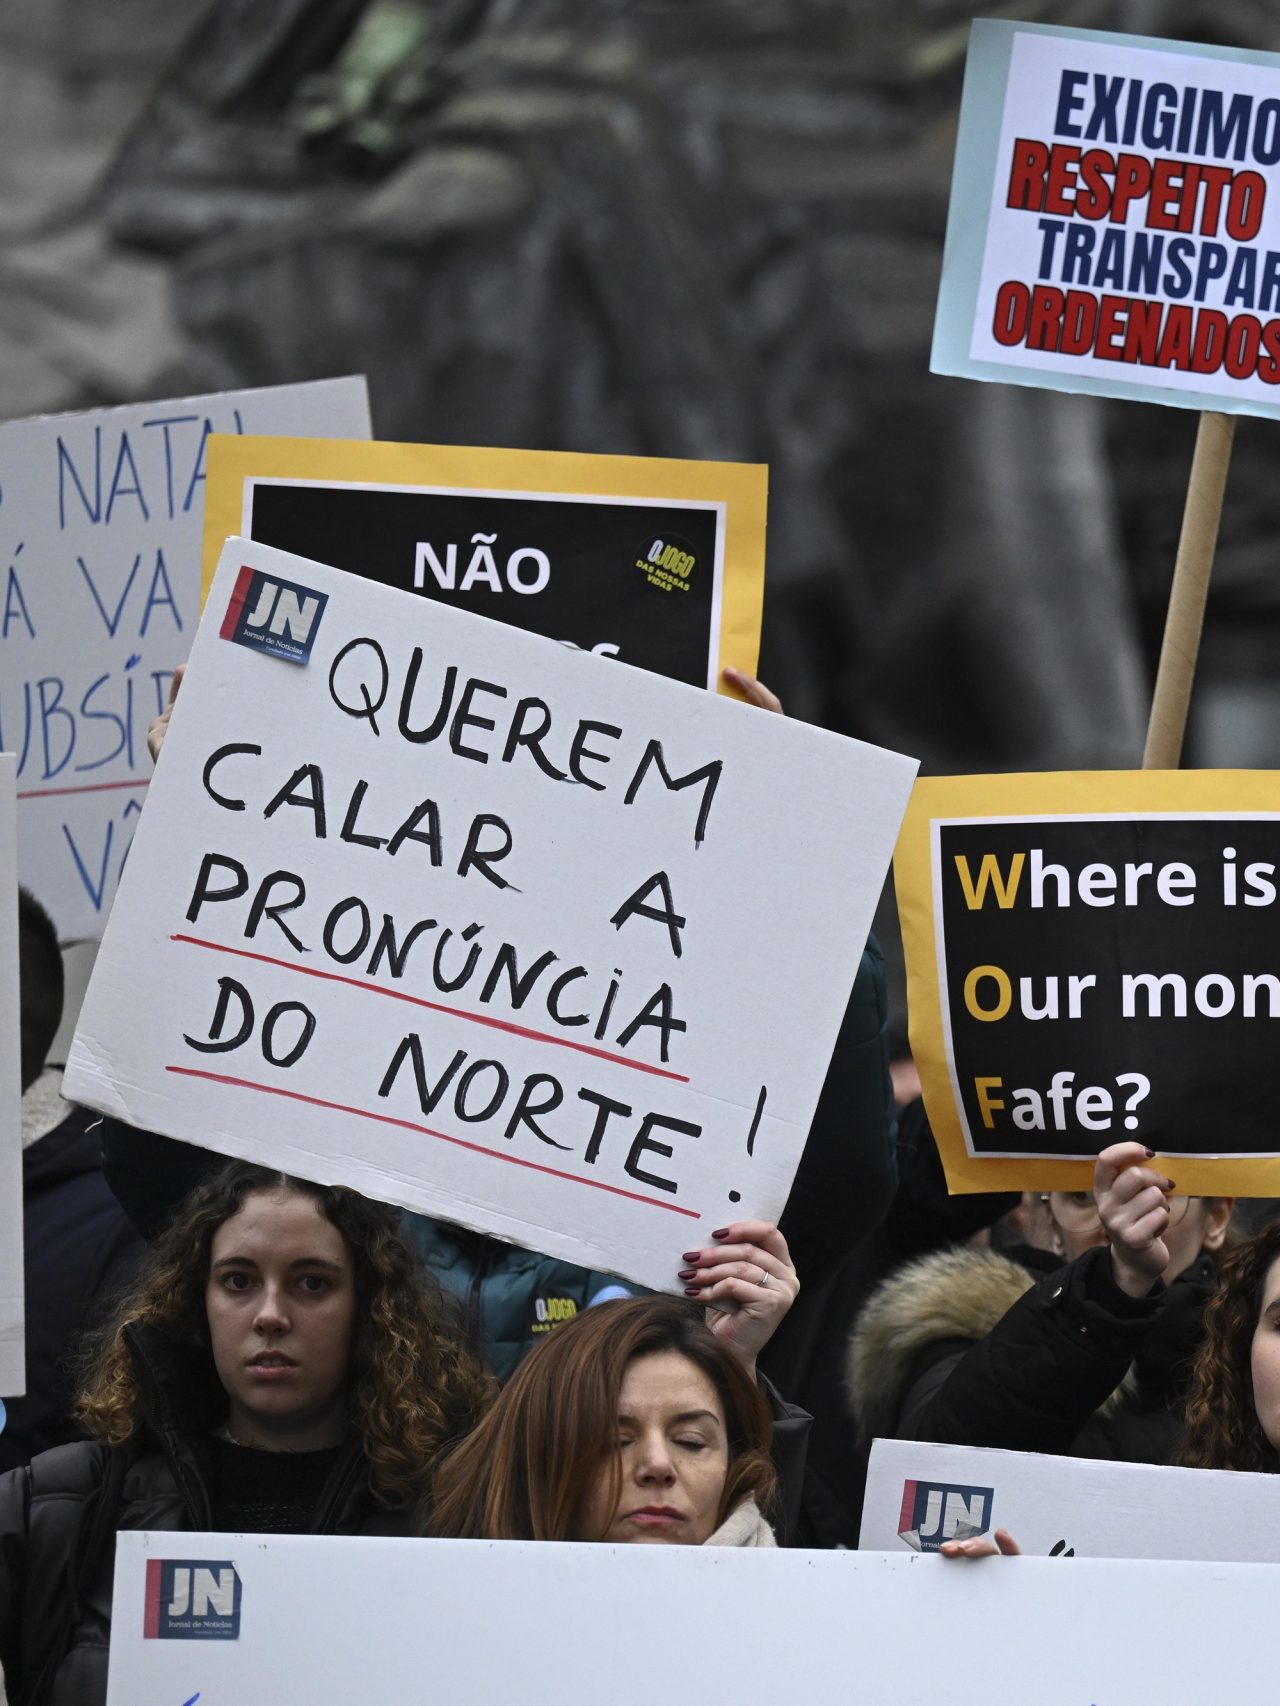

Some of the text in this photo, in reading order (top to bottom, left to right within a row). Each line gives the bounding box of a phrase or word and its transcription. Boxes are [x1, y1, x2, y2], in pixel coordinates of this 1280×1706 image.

[1006, 138, 1267, 241] RESPEITO
[413, 532, 551, 595] NÃO
[636, 560, 690, 591] DAS NOSSAS
[647, 574, 673, 592] VIDAS
[243, 628, 265, 641] Jornal
[247, 581, 320, 644] JN
[328, 636, 724, 850] QUEREM
[202, 742, 687, 959] CALAR A
[954, 846, 1277, 911] Where is
[183, 976, 316, 1068] DO
[964, 965, 1097, 1022] Our
[974, 1071, 1151, 1131] Fafe?
[920, 1490, 984, 1538] JN
[168, 1568, 235, 1616] JN
